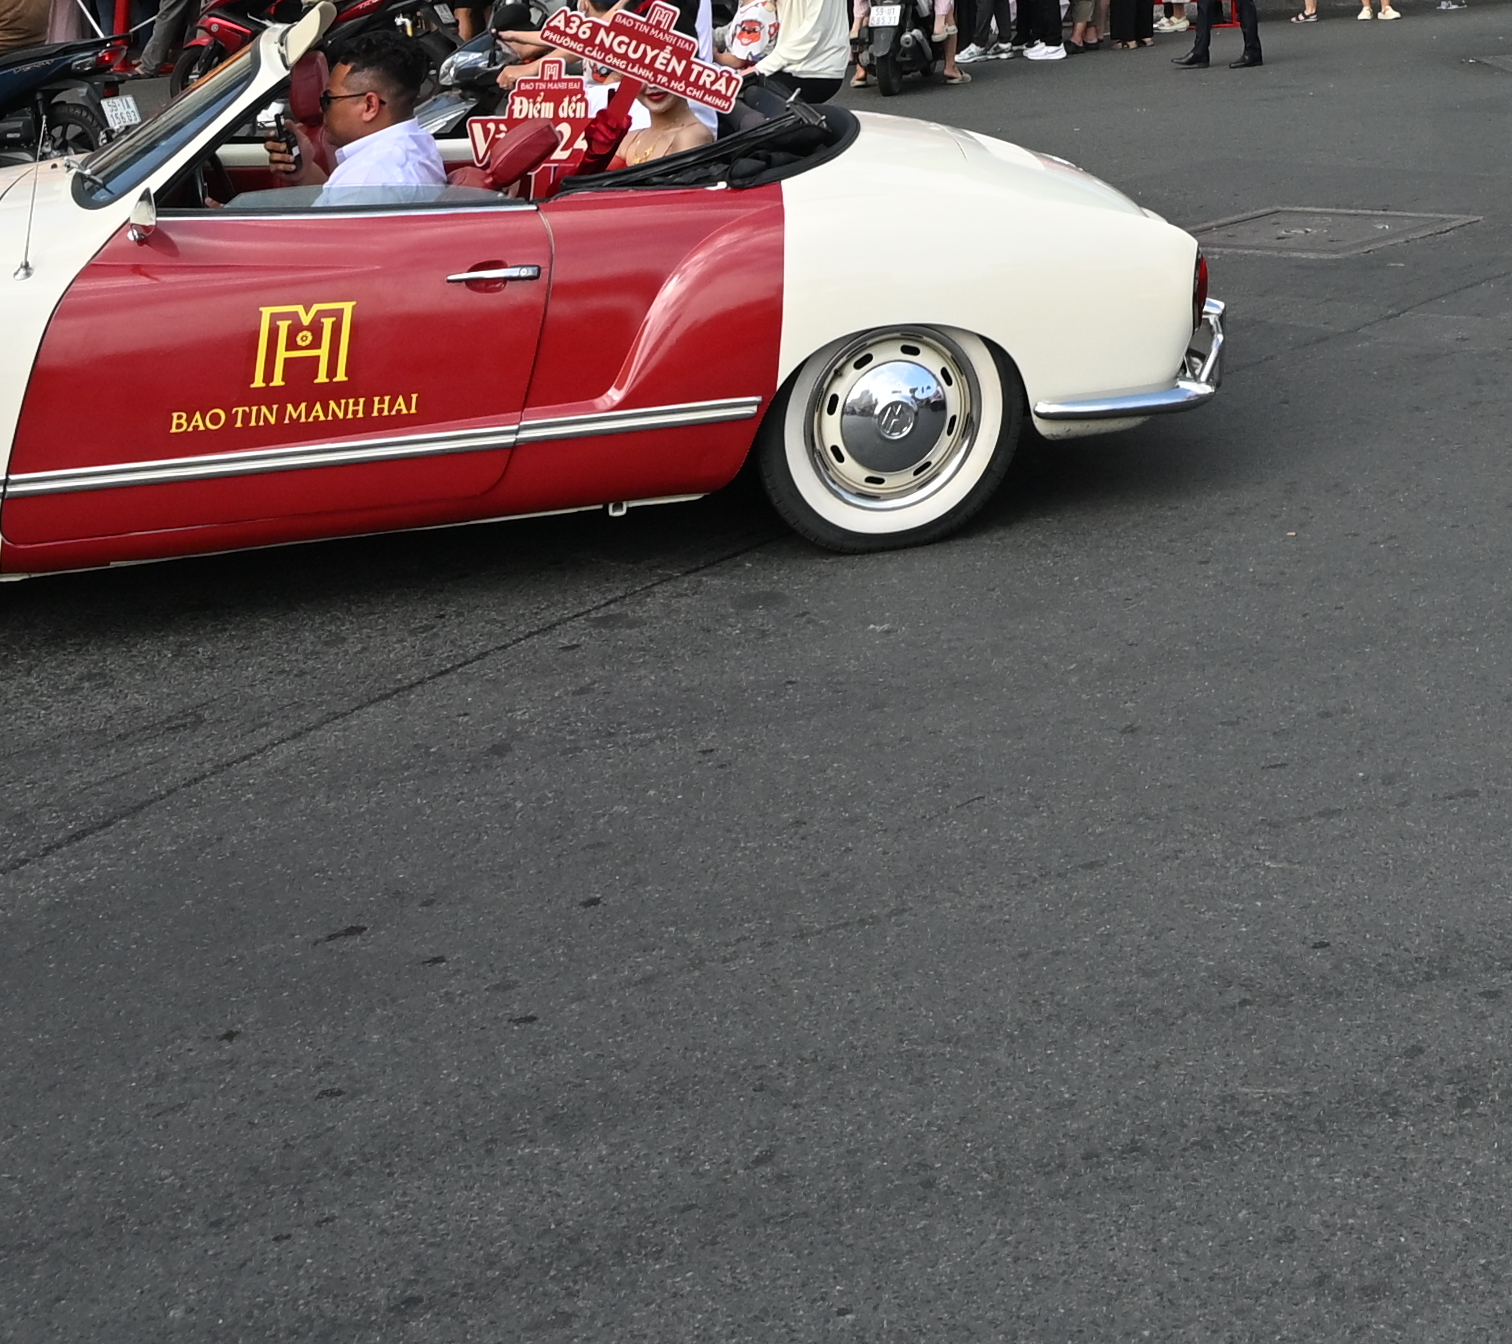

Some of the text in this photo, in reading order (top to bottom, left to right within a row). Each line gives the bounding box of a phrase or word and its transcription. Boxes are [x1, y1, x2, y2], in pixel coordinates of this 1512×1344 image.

[615, 13, 694, 51] BAO TIN MANH HAI
[543, 30, 730, 109] PHƯỜNG CẦU ÔNG LÃNH, TP. HỒ CHÍ MINH
[550, 12, 738, 97] A36 NGUYỄN TRÃI
[513, 92, 586, 119] Điểm đến
[169, 393, 419, 433] BAO TIN MANH HAI
